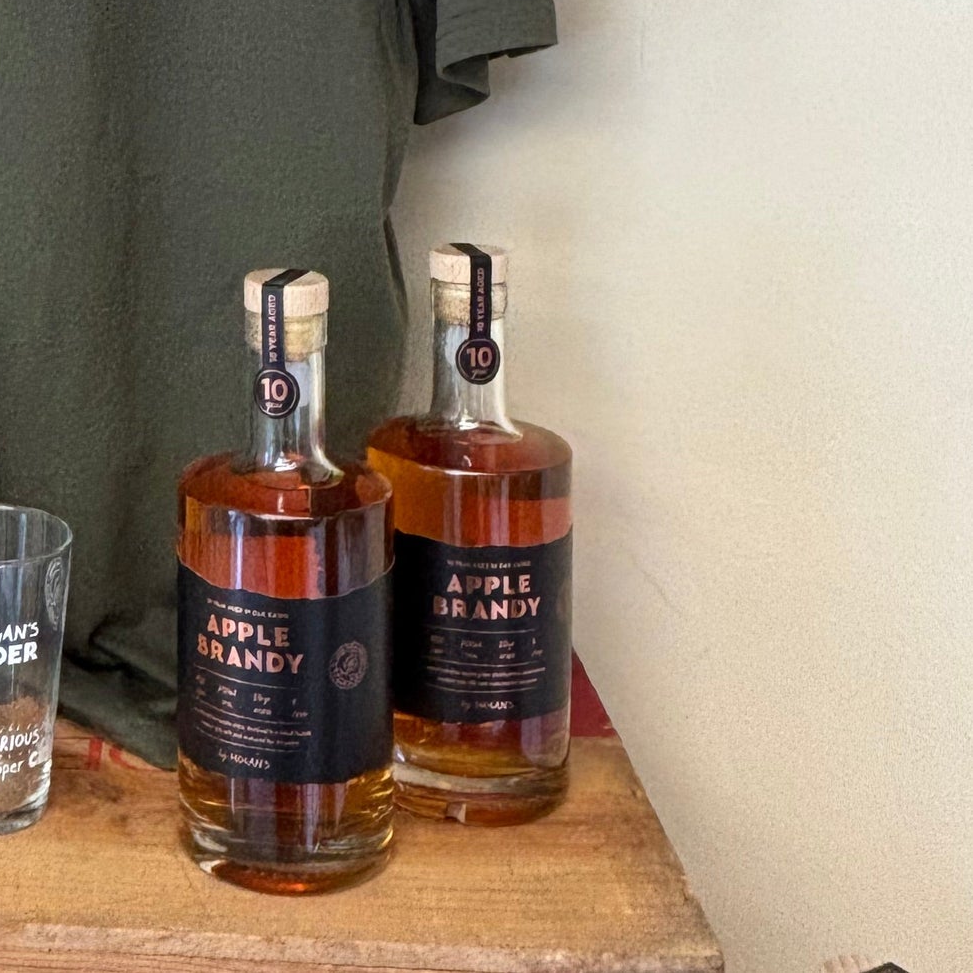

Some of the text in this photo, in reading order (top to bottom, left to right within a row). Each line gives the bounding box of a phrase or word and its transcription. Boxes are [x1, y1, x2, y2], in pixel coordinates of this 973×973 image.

[466, 346, 493, 368] 10
[260, 377, 288, 401] 10
[446, 573, 531, 596] APPLE
[433, 596, 541, 621] BRANDY
[207, 613, 290, 647] APPLE
[197, 633, 304, 674] BRANDY
